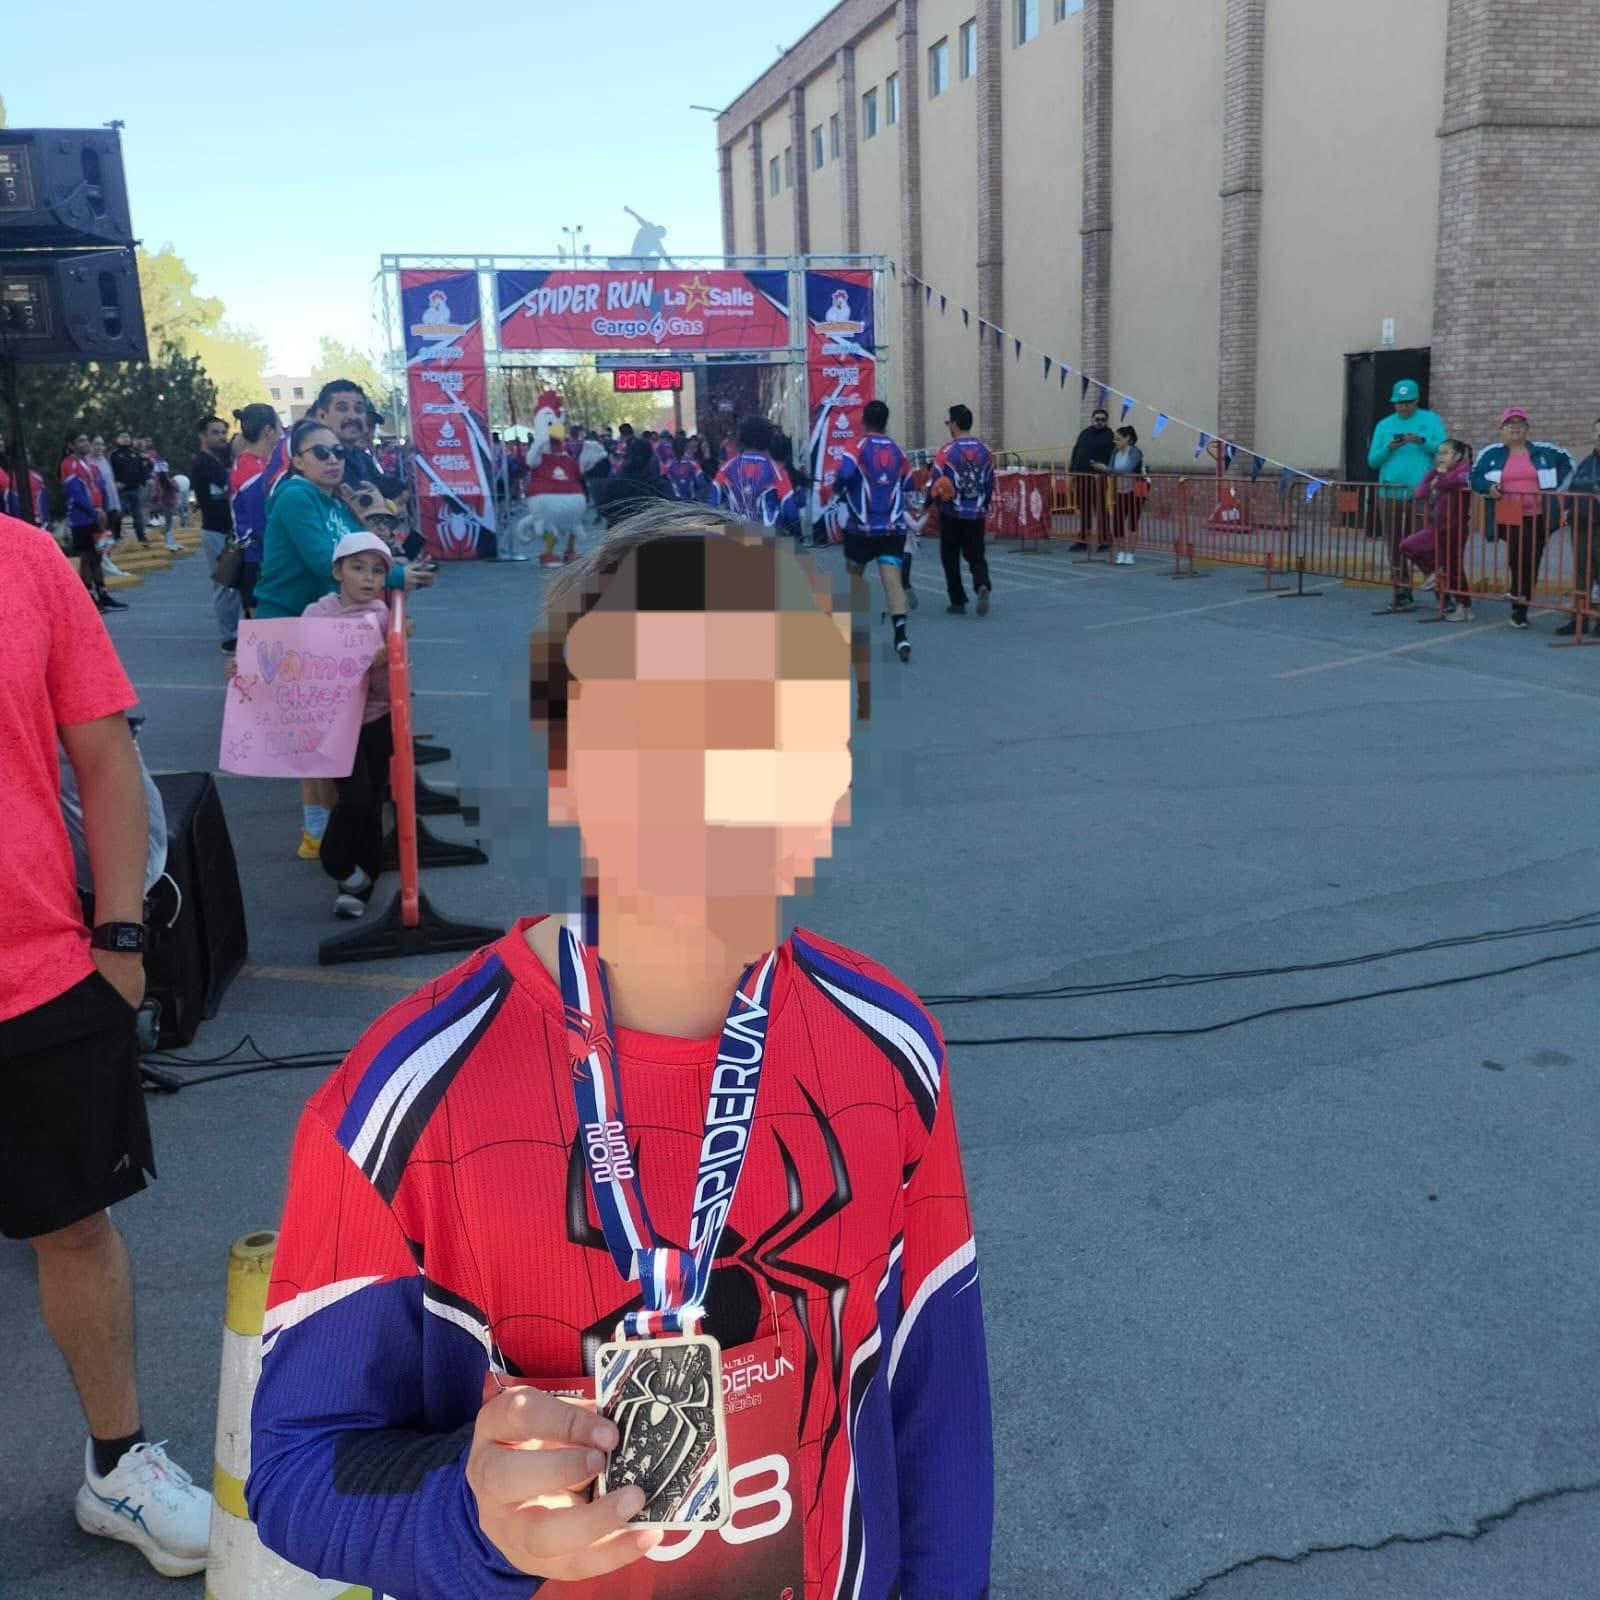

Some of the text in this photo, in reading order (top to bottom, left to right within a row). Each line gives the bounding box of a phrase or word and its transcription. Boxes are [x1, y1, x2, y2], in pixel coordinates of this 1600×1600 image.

[524, 278, 654, 318] SPIDER RUN
[664, 287, 754, 307] La Salle
[593, 317, 704, 337] Cargo Gas
[689, 990, 769, 1250] SPIDERUN
[721, 1354, 755, 1371] ALTILLO
